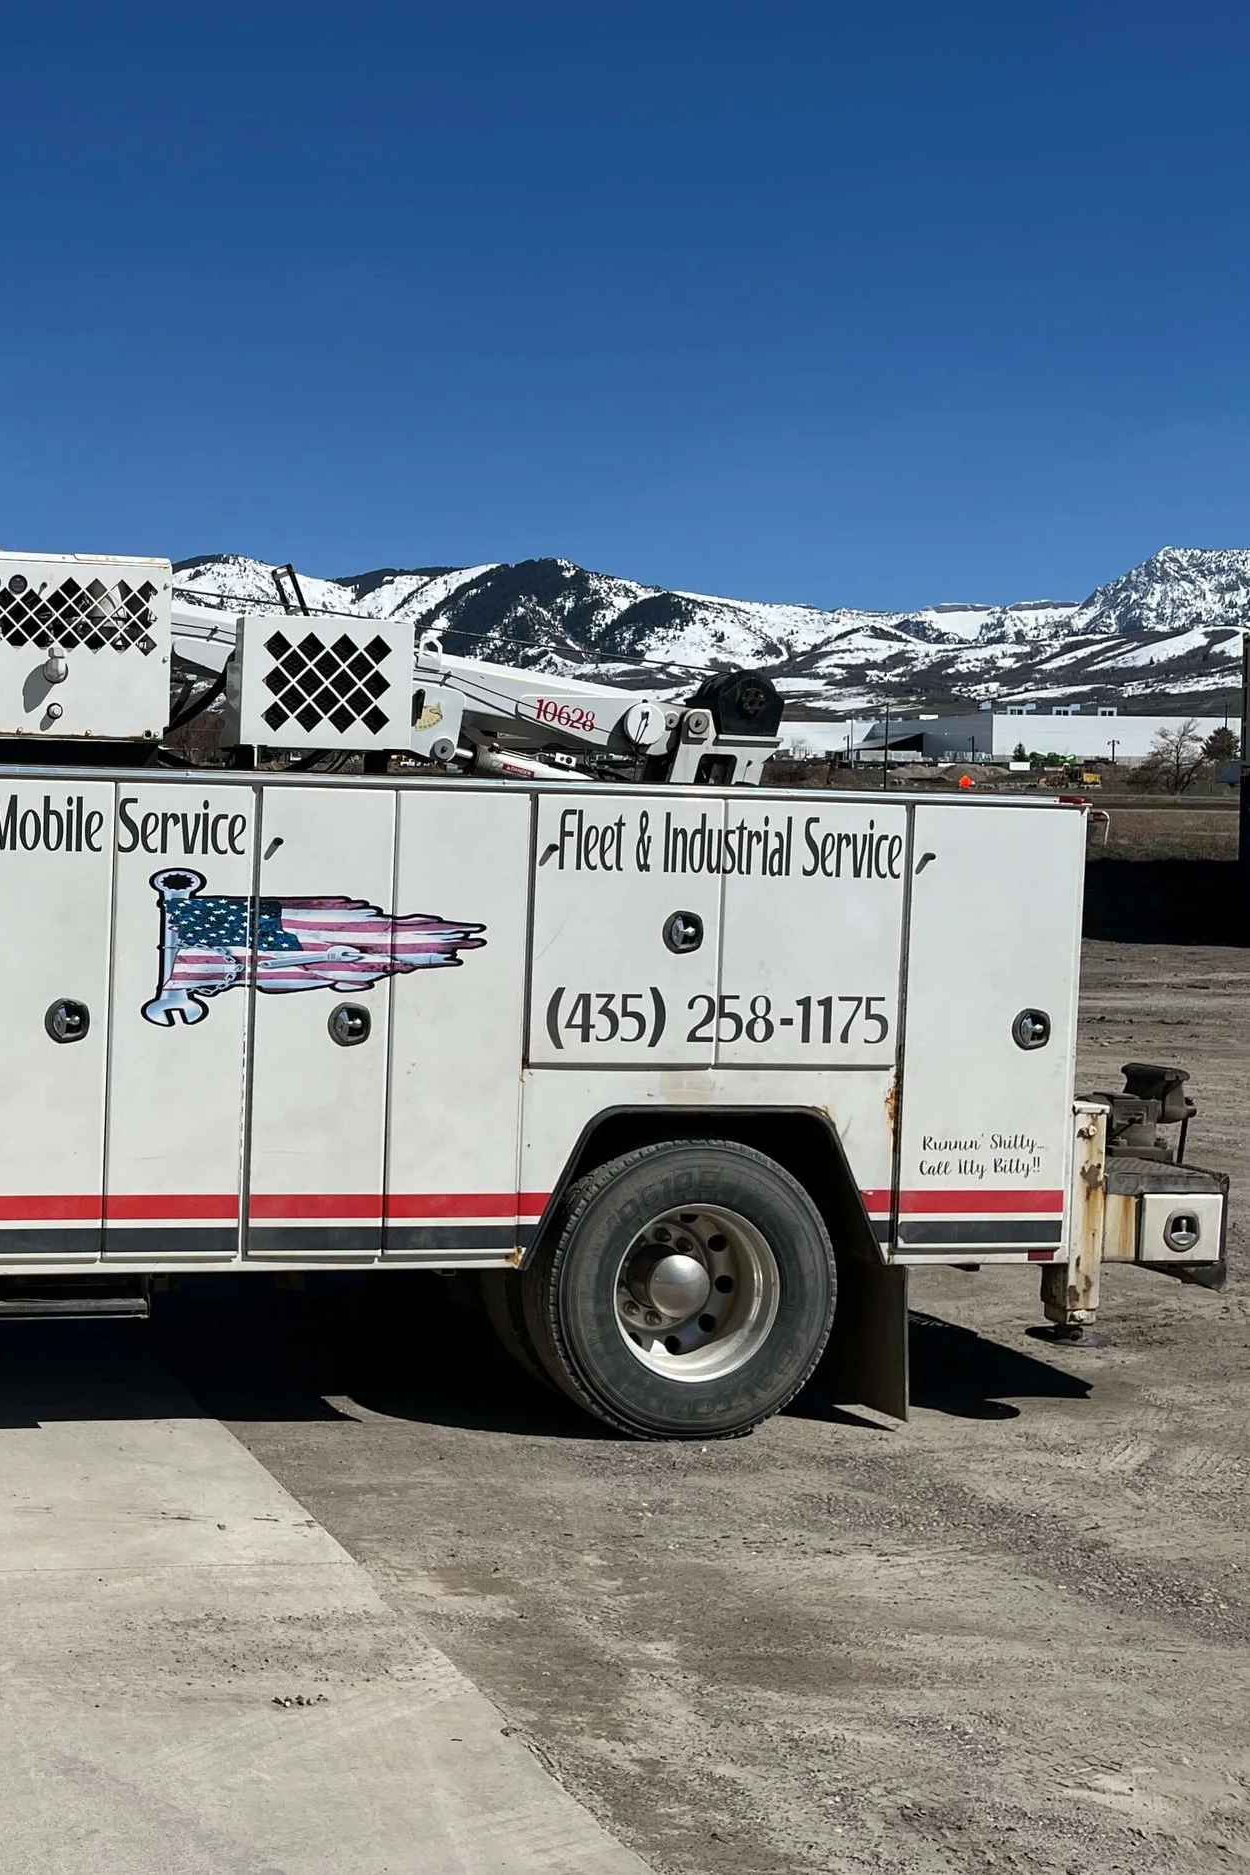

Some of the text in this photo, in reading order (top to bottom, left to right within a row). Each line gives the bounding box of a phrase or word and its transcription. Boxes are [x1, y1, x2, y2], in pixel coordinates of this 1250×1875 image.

[536, 698, 596, 732] 10628
[117, 797, 247, 855] Service
[557, 808, 903, 880] Fleet & Industrial Service
[545, 986, 889, 1050] (435) 258-1175
[919, 1155, 1041, 1180] Call Itty Bitty!!
